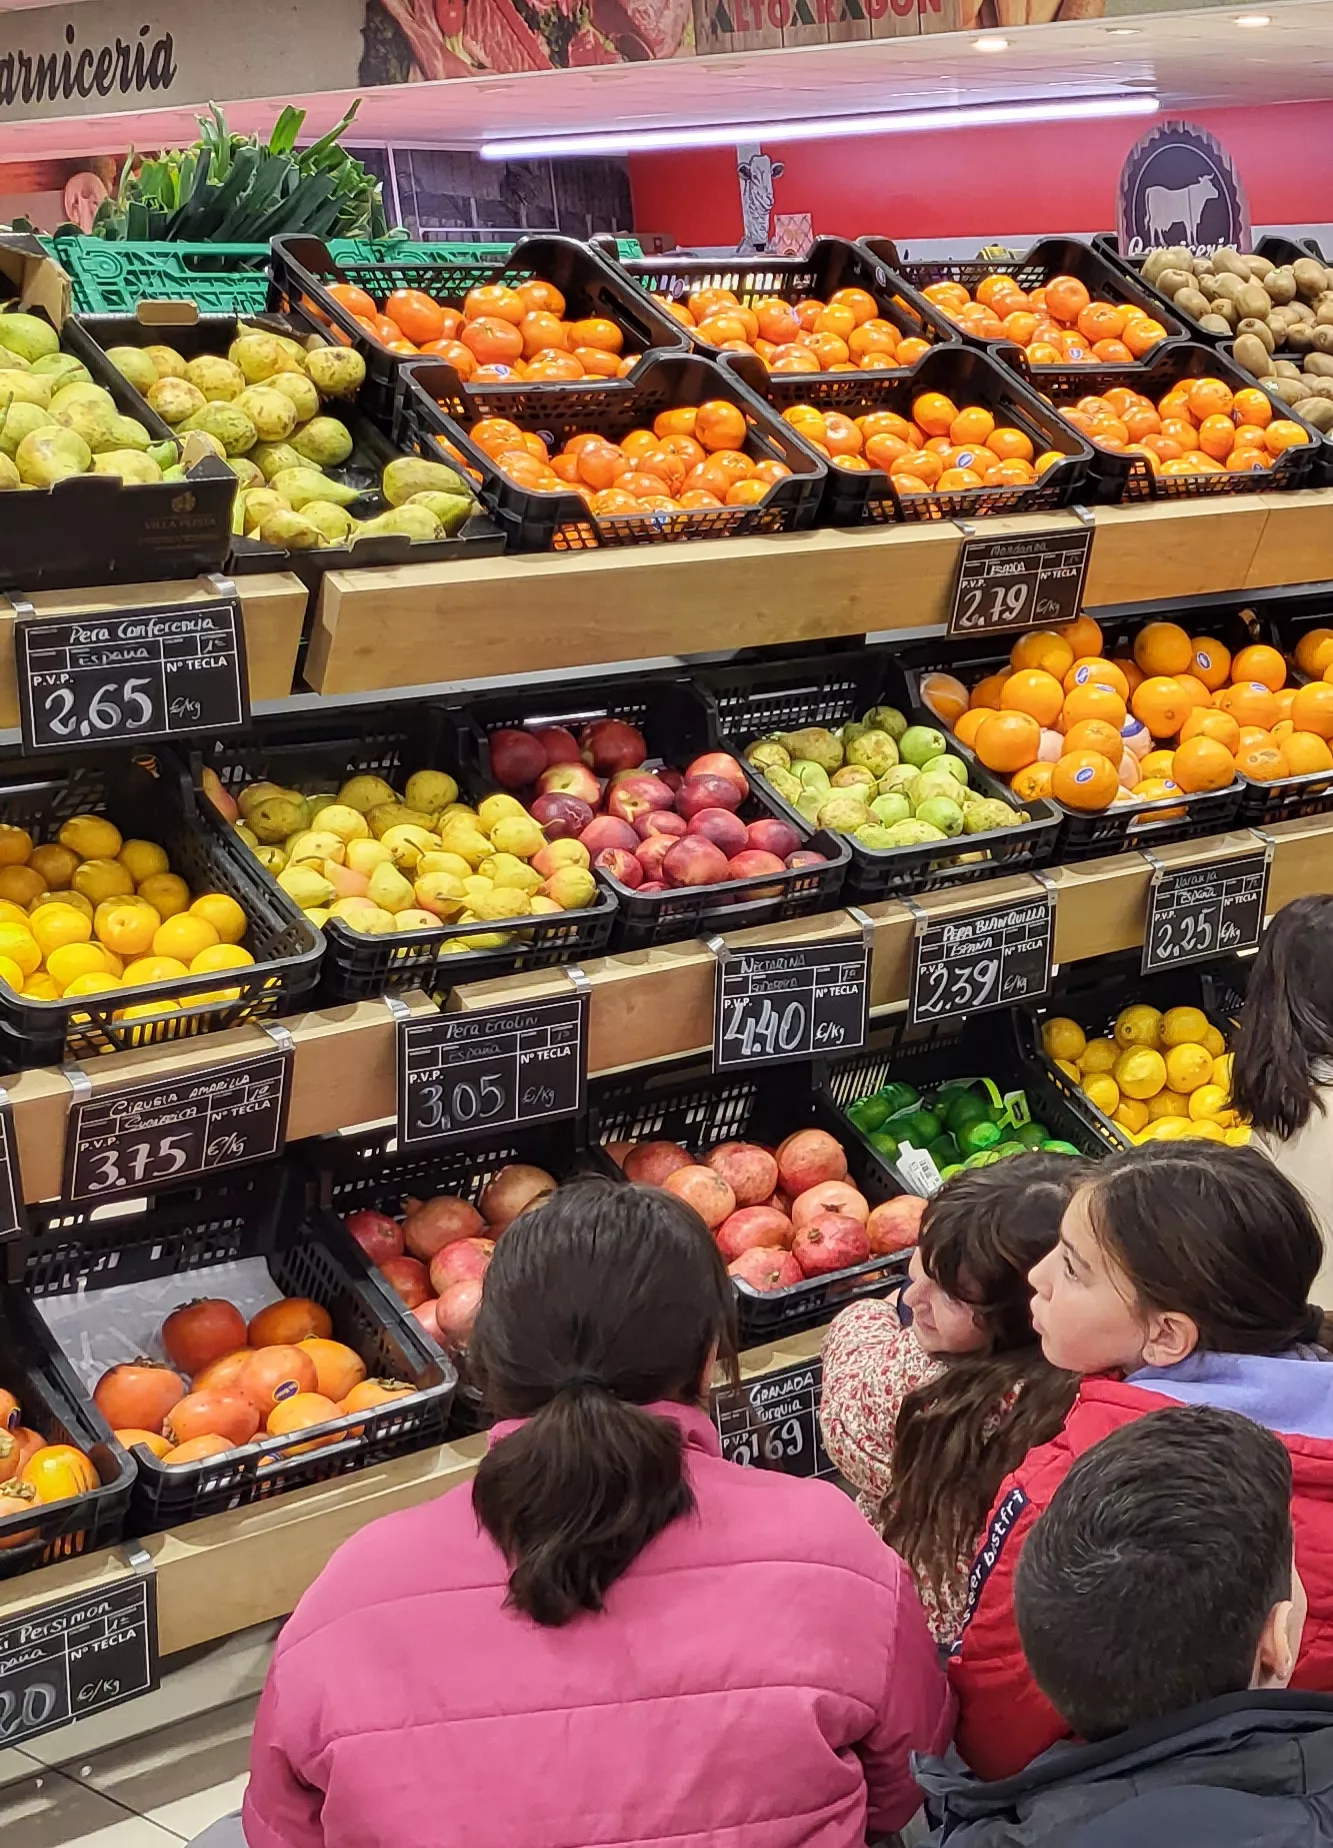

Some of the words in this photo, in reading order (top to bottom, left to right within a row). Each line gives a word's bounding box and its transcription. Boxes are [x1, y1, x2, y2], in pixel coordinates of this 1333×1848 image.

[1053, 568, 1077, 578] TECLA
[69, 625, 110, 644] Pera
[118, 614, 219, 639] Conferencia
[33, 674, 74, 686] P.V.P.
[187, 657, 228, 670] TECLA
[1234, 893, 1258, 905] TECLA
[1017, 939, 1043, 954] TECLA
[829, 984, 859, 996] TECLA
[446, 1022, 480, 1040] Pera
[409, 1070, 444, 1084] P.V.P.
[538, 1046, 572, 1061] TECLA
[81, 1136, 121, 1152] P.V.P.
[231, 1101, 272, 1117] TECLA
[749, 1371, 815, 1408] GRANADA
[20, 1601, 113, 1644] Persimon
[92, 1628, 137, 1653] TECLA
